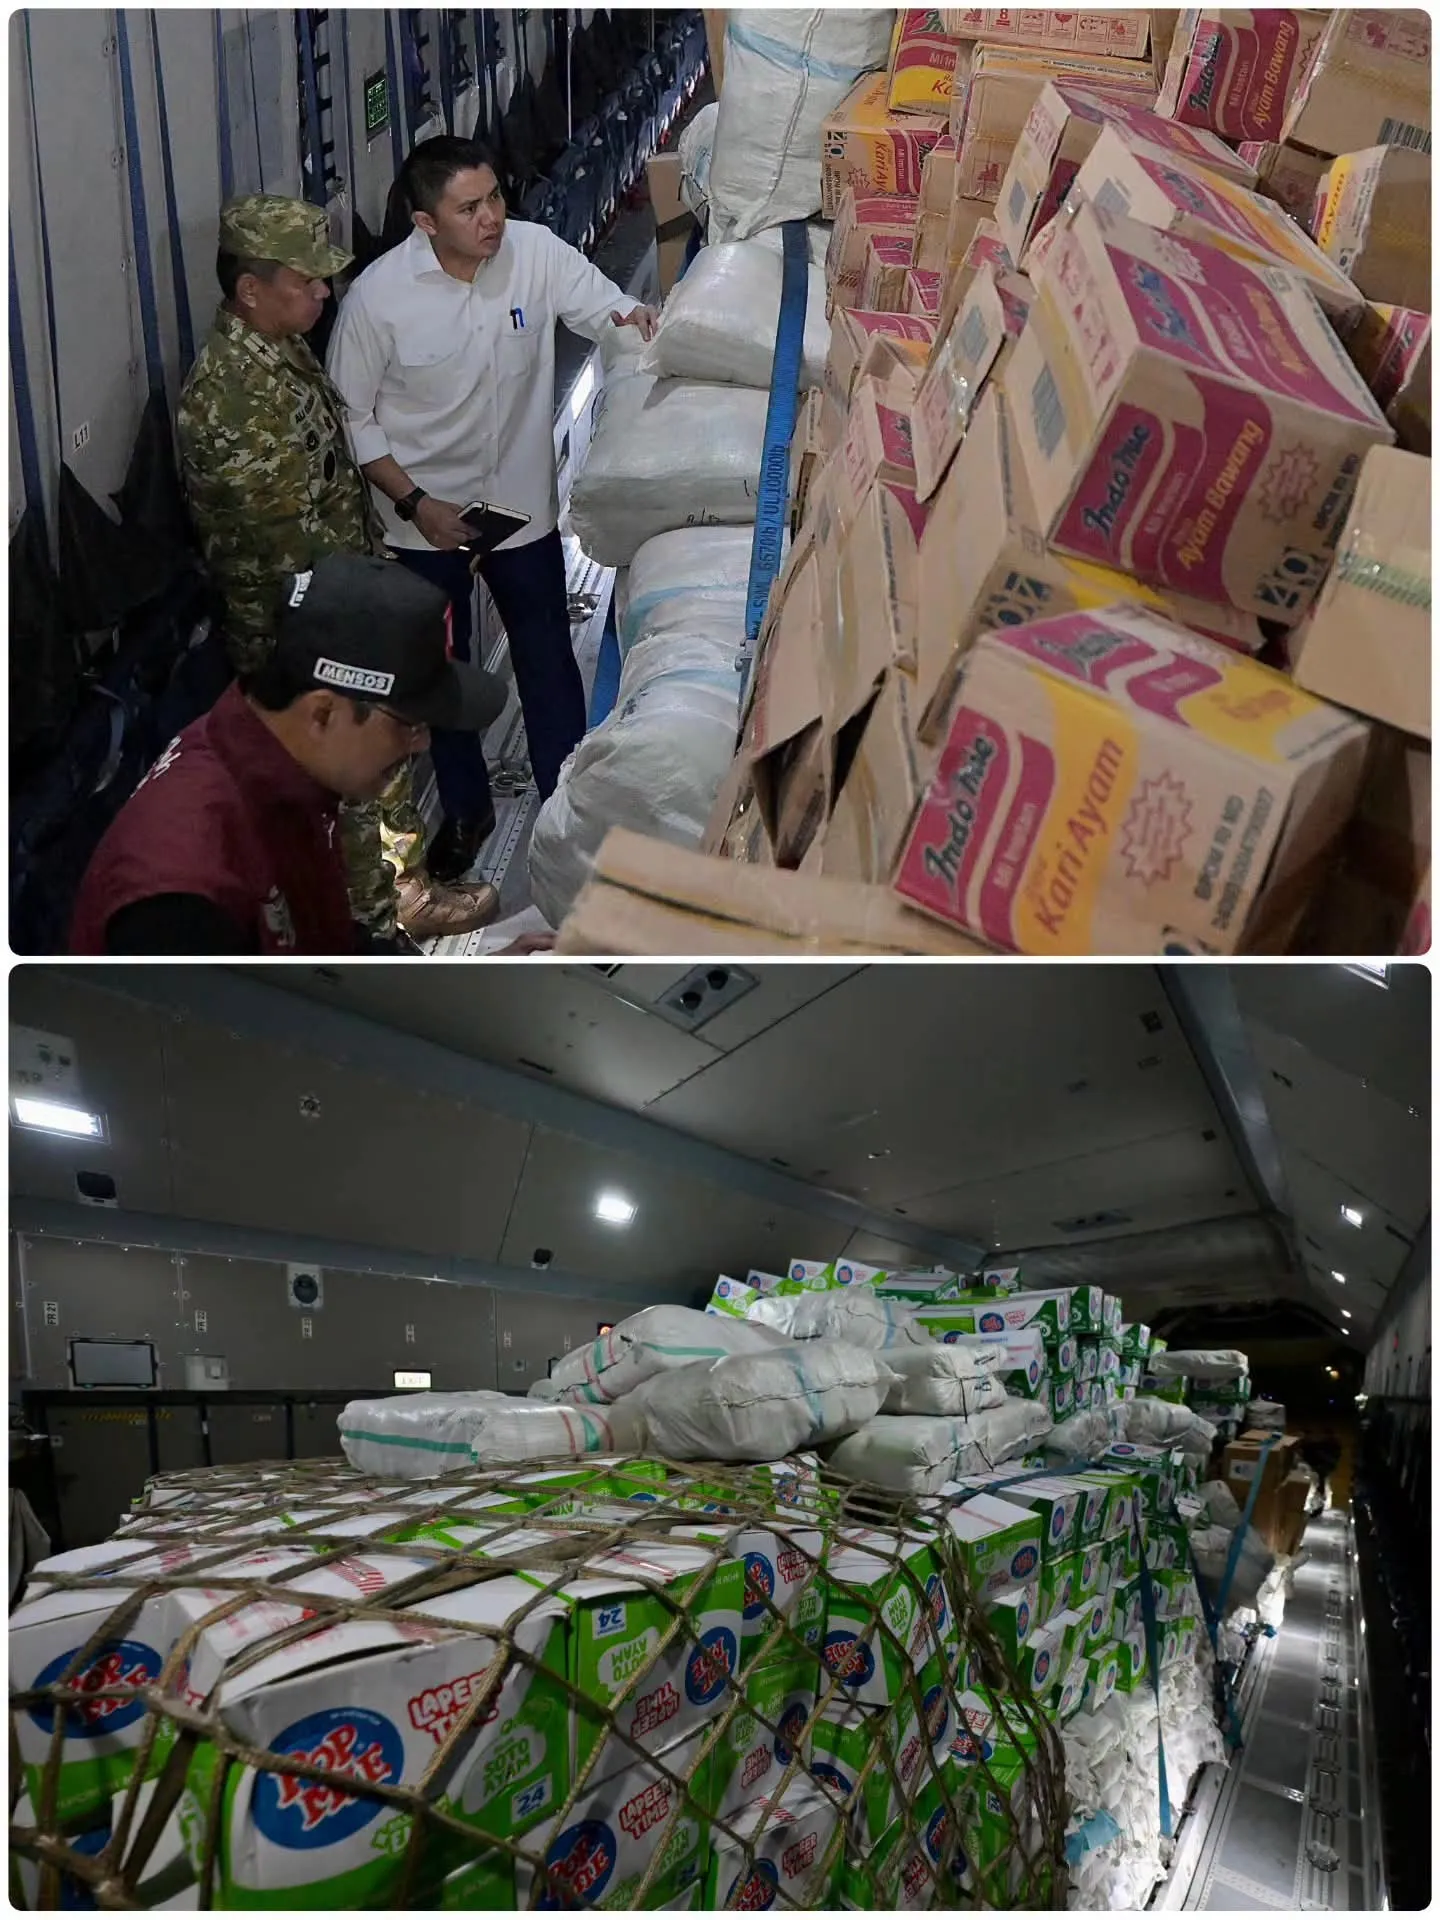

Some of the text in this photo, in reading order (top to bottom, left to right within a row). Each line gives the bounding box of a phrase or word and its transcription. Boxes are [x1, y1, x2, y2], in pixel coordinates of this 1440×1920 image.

[1251, 86, 1275, 129] Ayam
[1263, 20, 1295, 85] Bawang
[875, 141, 889, 171] Kari
[1083, 423, 1151, 543] Indomie
[1176, 509, 1217, 571] Ayam
[1206, 418, 1265, 511] Bawang
[321, 664, 387, 689] MENSOS
[924, 737, 998, 889] Indomie
[1034, 841, 1084, 936] Kari
[1065, 737, 1125, 855] Ayam
[598, 1609, 622, 1629] 24
[611, 1637, 648, 1667] AYAM
[408, 1668, 503, 1731] LAPEE
[630, 1691, 680, 1741] LAPEER
[636, 1681, 675, 1719] TIME
[268, 1724, 359, 1809] POP
[483, 1738, 528, 1774] SOTO
[483, 1754, 532, 1798] AYAM
[517, 1783, 545, 1814] 24
[619, 1776, 672, 1833] LAPEER
[630, 1797, 669, 1840] TIME
